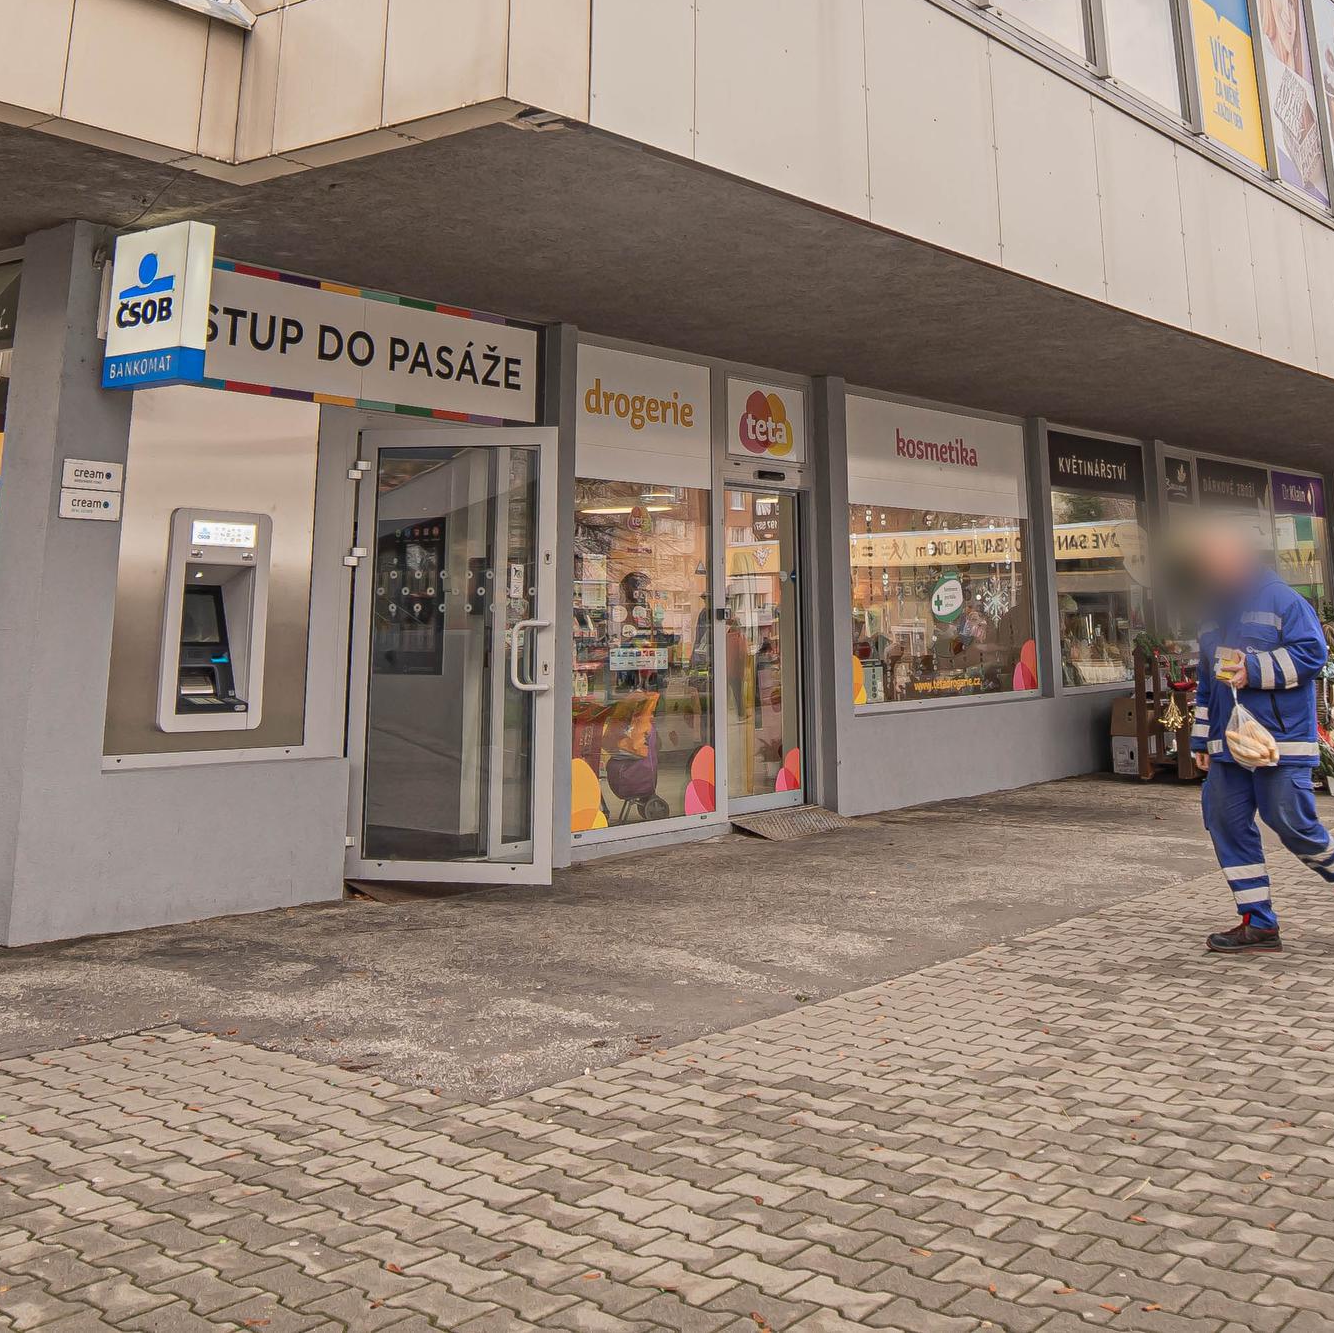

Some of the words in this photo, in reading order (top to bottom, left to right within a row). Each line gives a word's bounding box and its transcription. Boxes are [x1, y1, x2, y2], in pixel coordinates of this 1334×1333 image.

[1209, 34, 1238, 85] VÍCE
[116, 297, 174, 329] ČSOB
[109, 355, 173, 380] BANKOMAT
[317, 324, 375, 367] DO
[389, 341, 522, 391] PASÁŽE
[584, 378, 693, 430] drogerie
[746, 413, 787, 445] teta
[895, 428, 978, 467] kosmetika
[74, 468, 104, 480] cream
[1058, 455, 1127, 481] KVĚTINÁŘSTVÍ
[1202, 476, 1234, 496] DÁRKOVÉ
[71, 498, 102, 509] cream
